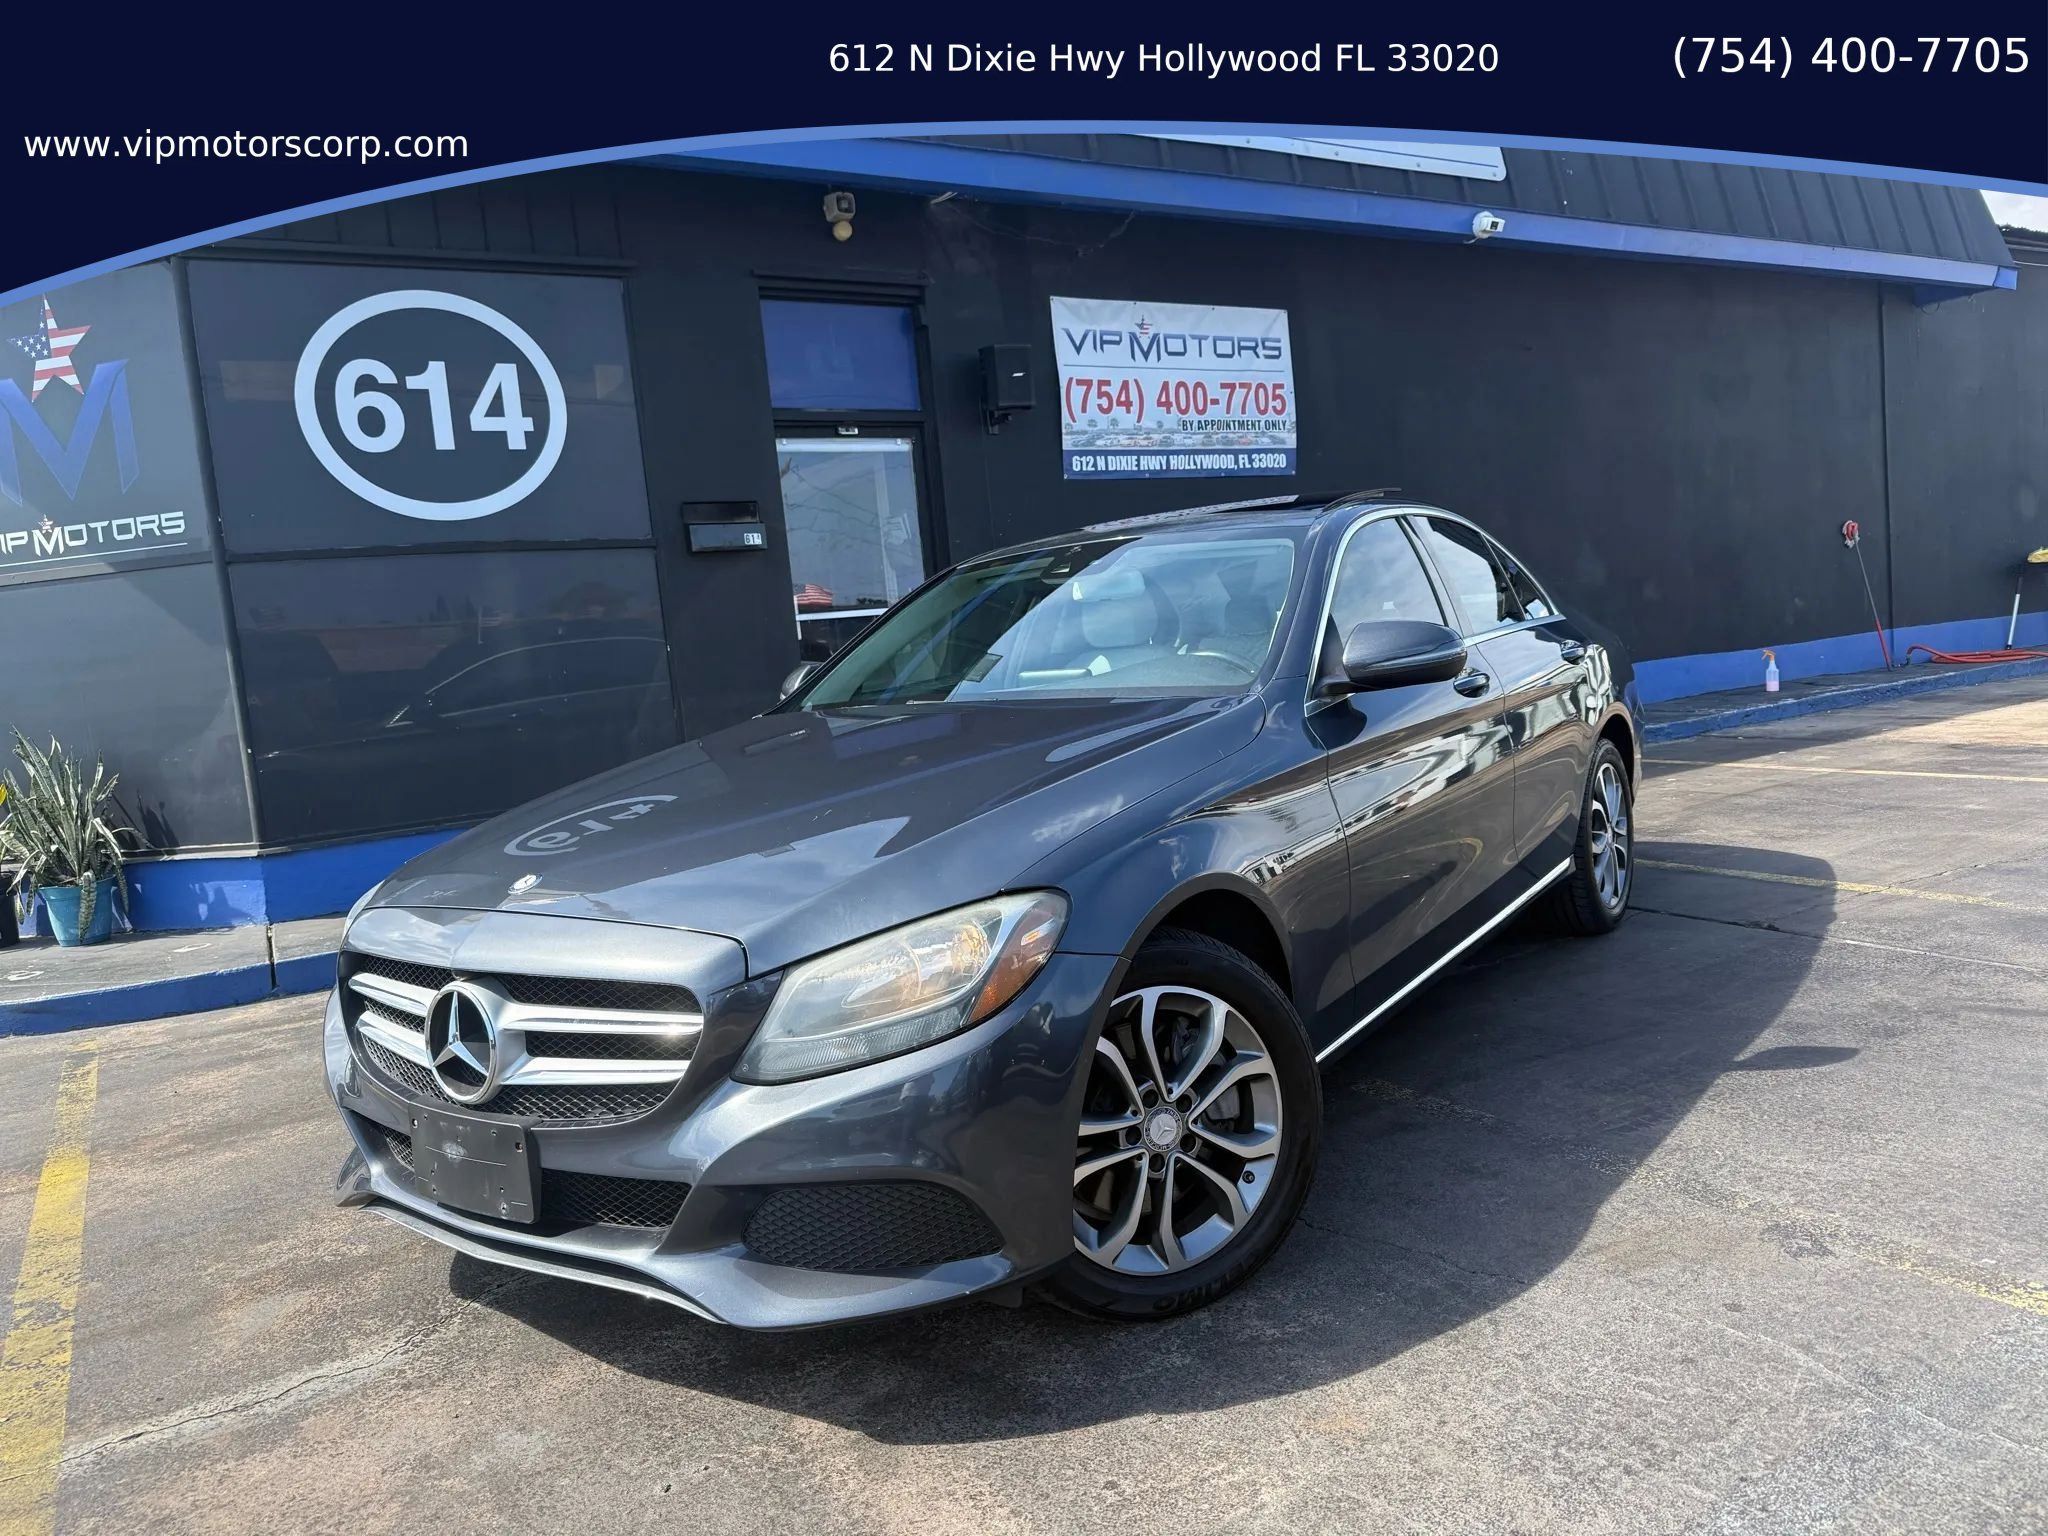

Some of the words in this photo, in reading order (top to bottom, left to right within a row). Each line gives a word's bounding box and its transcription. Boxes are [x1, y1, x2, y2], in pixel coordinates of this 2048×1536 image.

[1061, 327, 1123, 356] VIP
[1127, 331, 1283, 363] MOTORS
[334, 358, 534, 454] 614
[1064, 376, 1145, 423] (754)
[1156, 380, 1288, 417] 400-7705
[1181, 419, 1194, 432] BY
[1197, 419, 1262, 432] APPOINTMENT
[1264, 419, 1287, 432] ONLY
[1071, 455, 1095, 472] 612
[1096, 455, 1106, 471] N
[1107, 455, 1138, 471] DIXIE
[1139, 455, 1167, 471] HWY
[1169, 454, 1238, 470] HOLLYWOOD,
[1239, 454, 1252, 470] FL
[1252, 453, 1287, 469] 33020
[0, 530, 29, 555] IP
[32, 510, 186, 557] MOTORS
